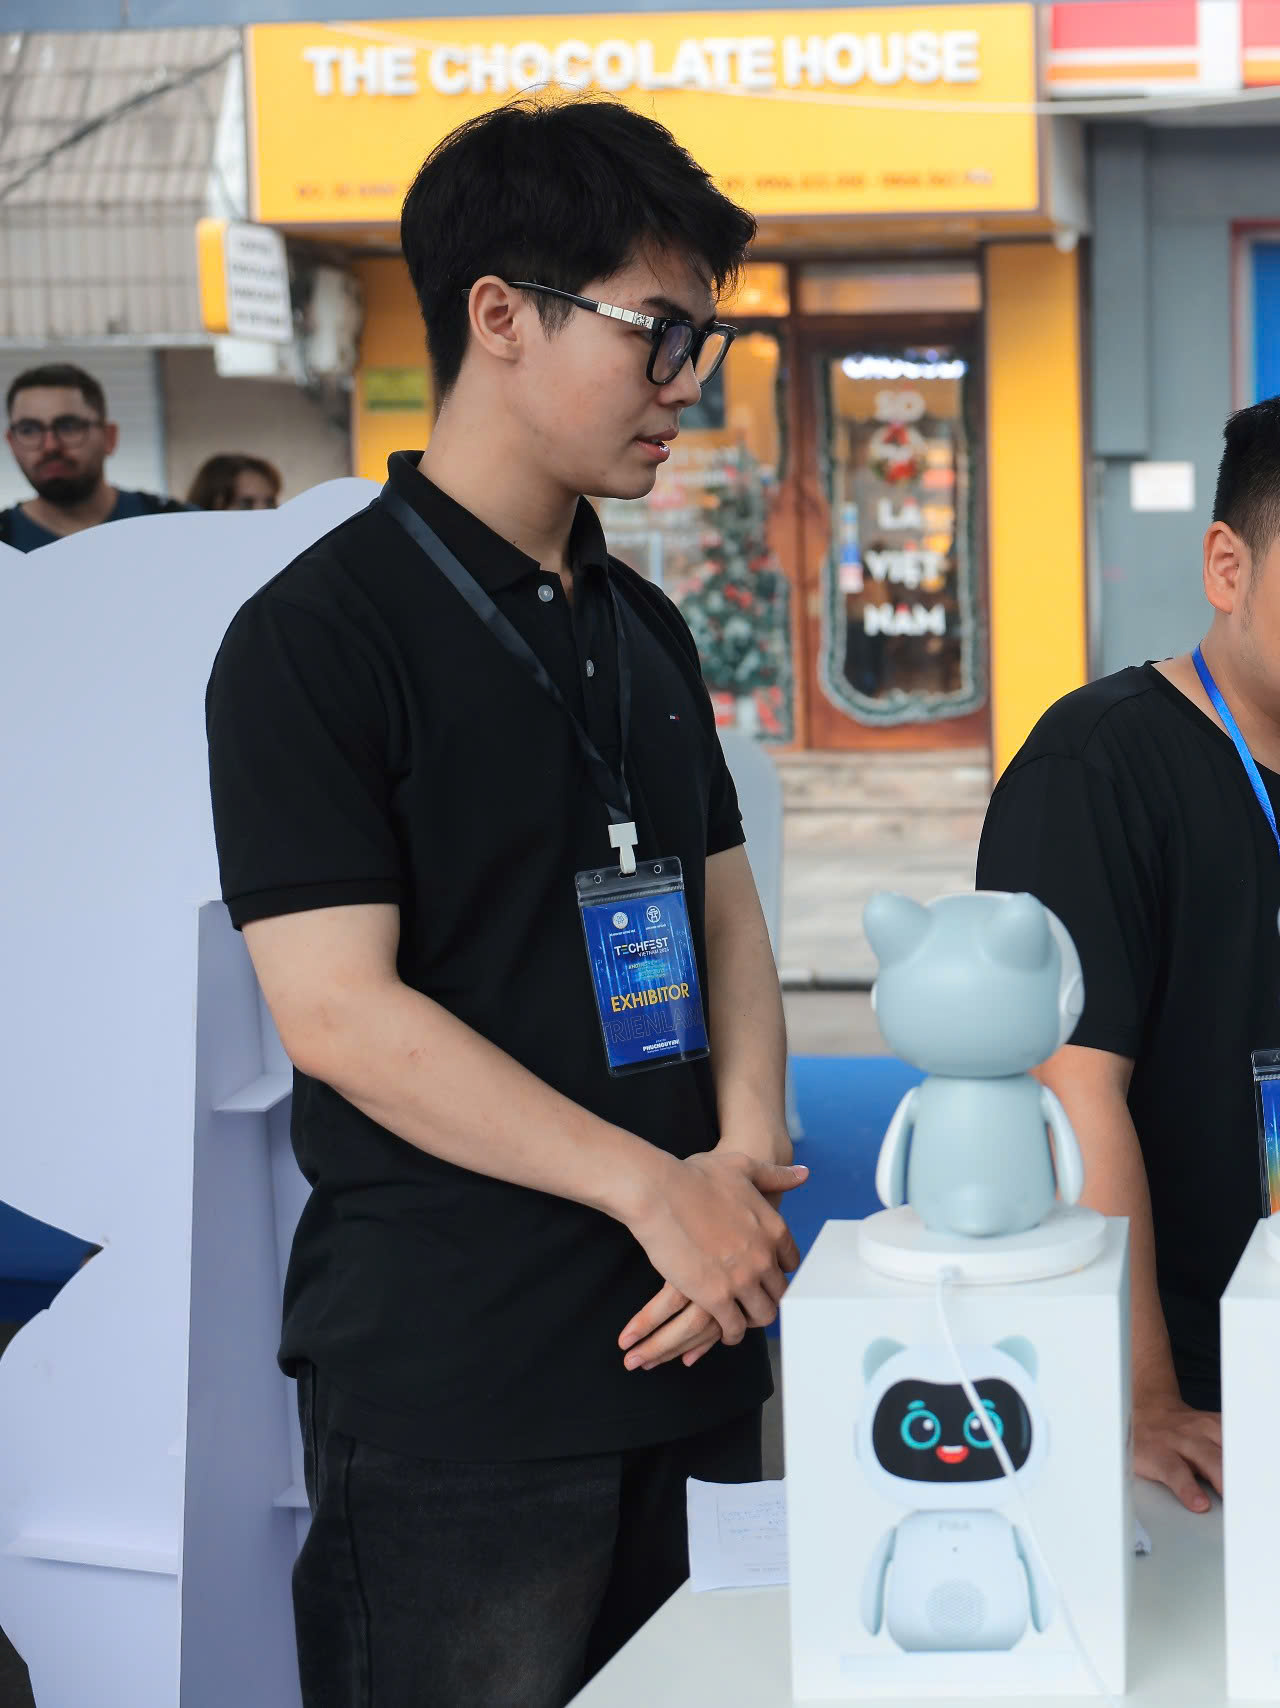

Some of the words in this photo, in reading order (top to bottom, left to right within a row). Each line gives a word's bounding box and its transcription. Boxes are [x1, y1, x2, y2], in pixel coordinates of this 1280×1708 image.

[303, 46, 418, 96] THE
[428, 37, 776, 95] CHOCOLATE
[782, 29, 980, 88] HOUSE
[863, 603, 945, 635] NAM
[614, 937, 668, 956] TECHFEST
[611, 982, 689, 1012] EXHIBITOR
